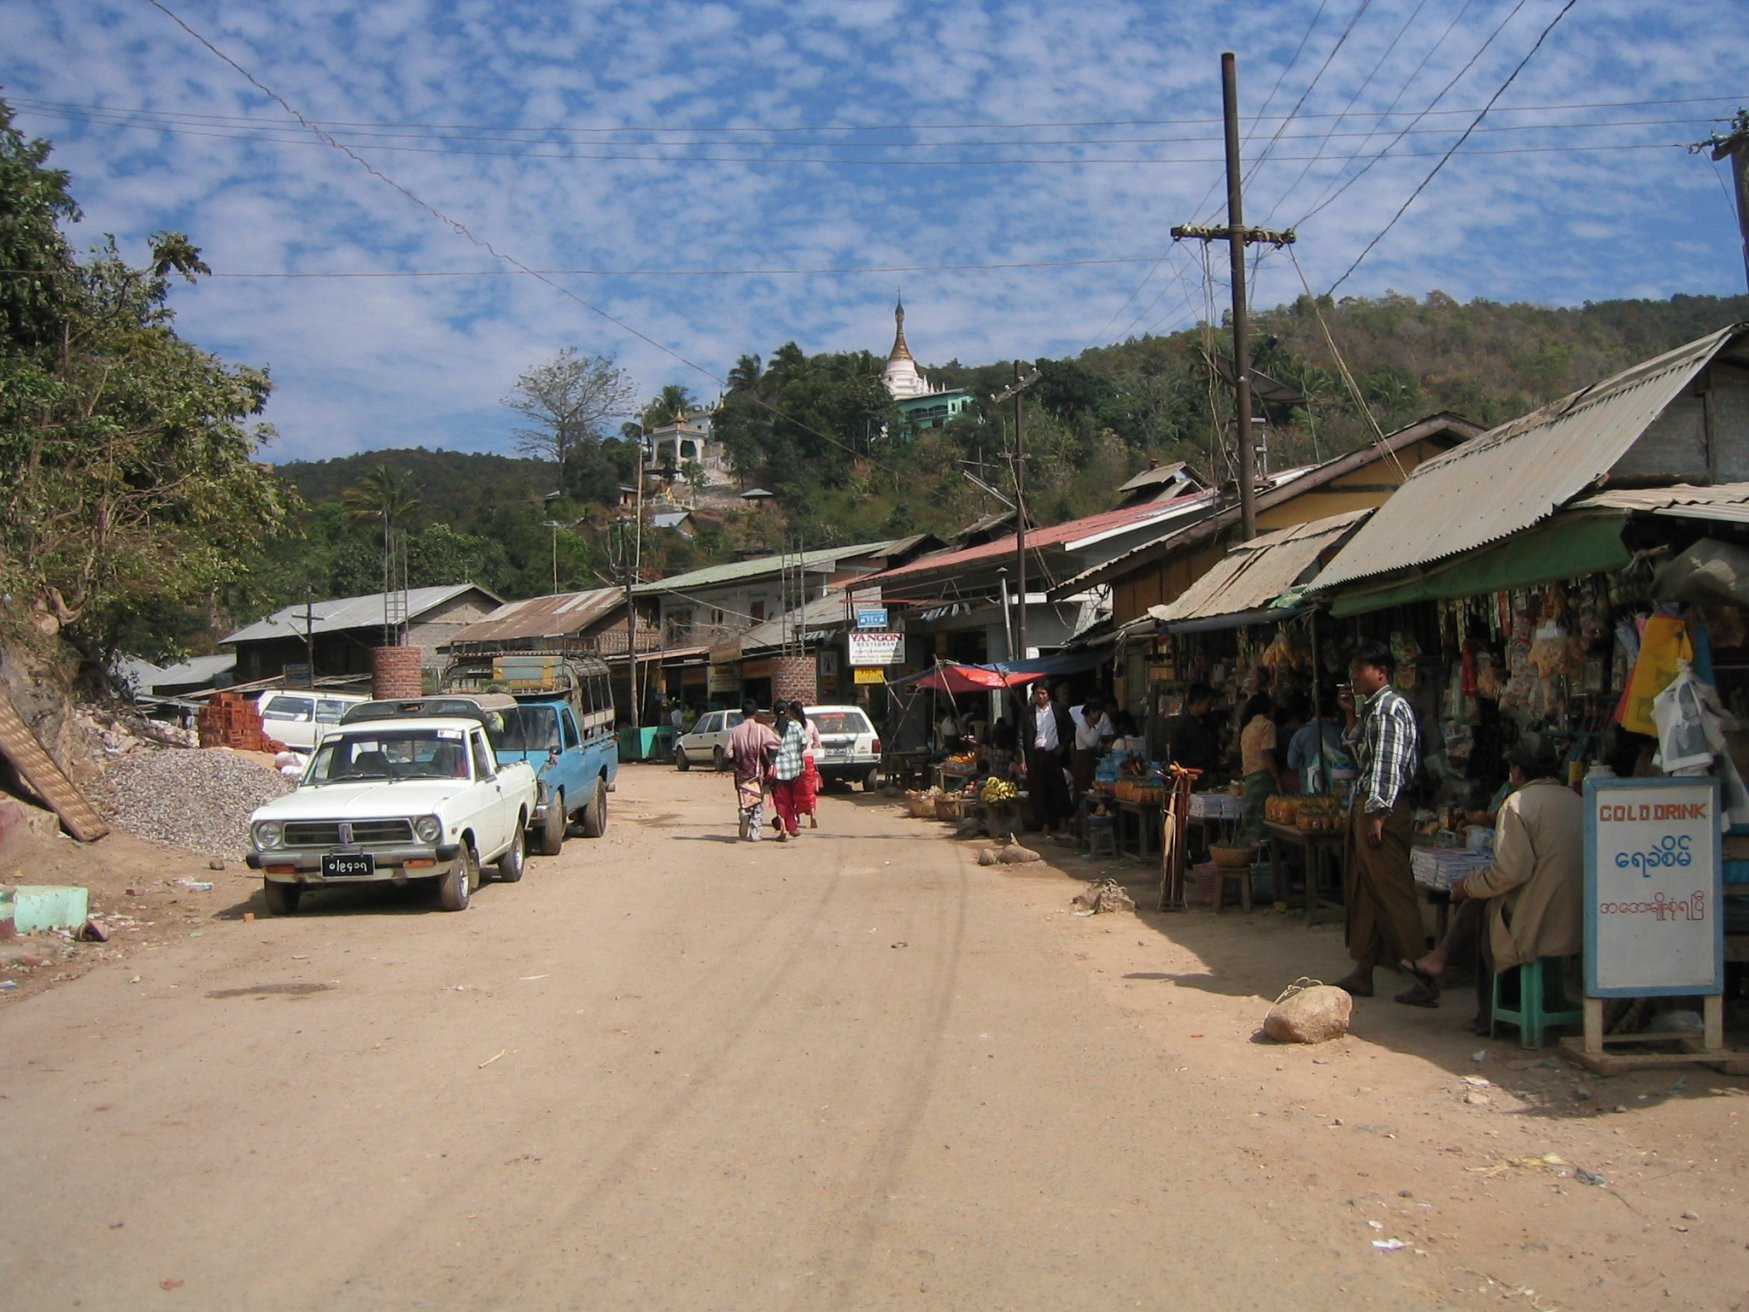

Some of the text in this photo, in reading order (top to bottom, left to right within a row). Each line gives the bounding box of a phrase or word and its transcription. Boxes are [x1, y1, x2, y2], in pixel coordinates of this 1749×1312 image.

[851, 633, 903, 642] YANGON
[1599, 802, 1707, 822] COLD DRINK
